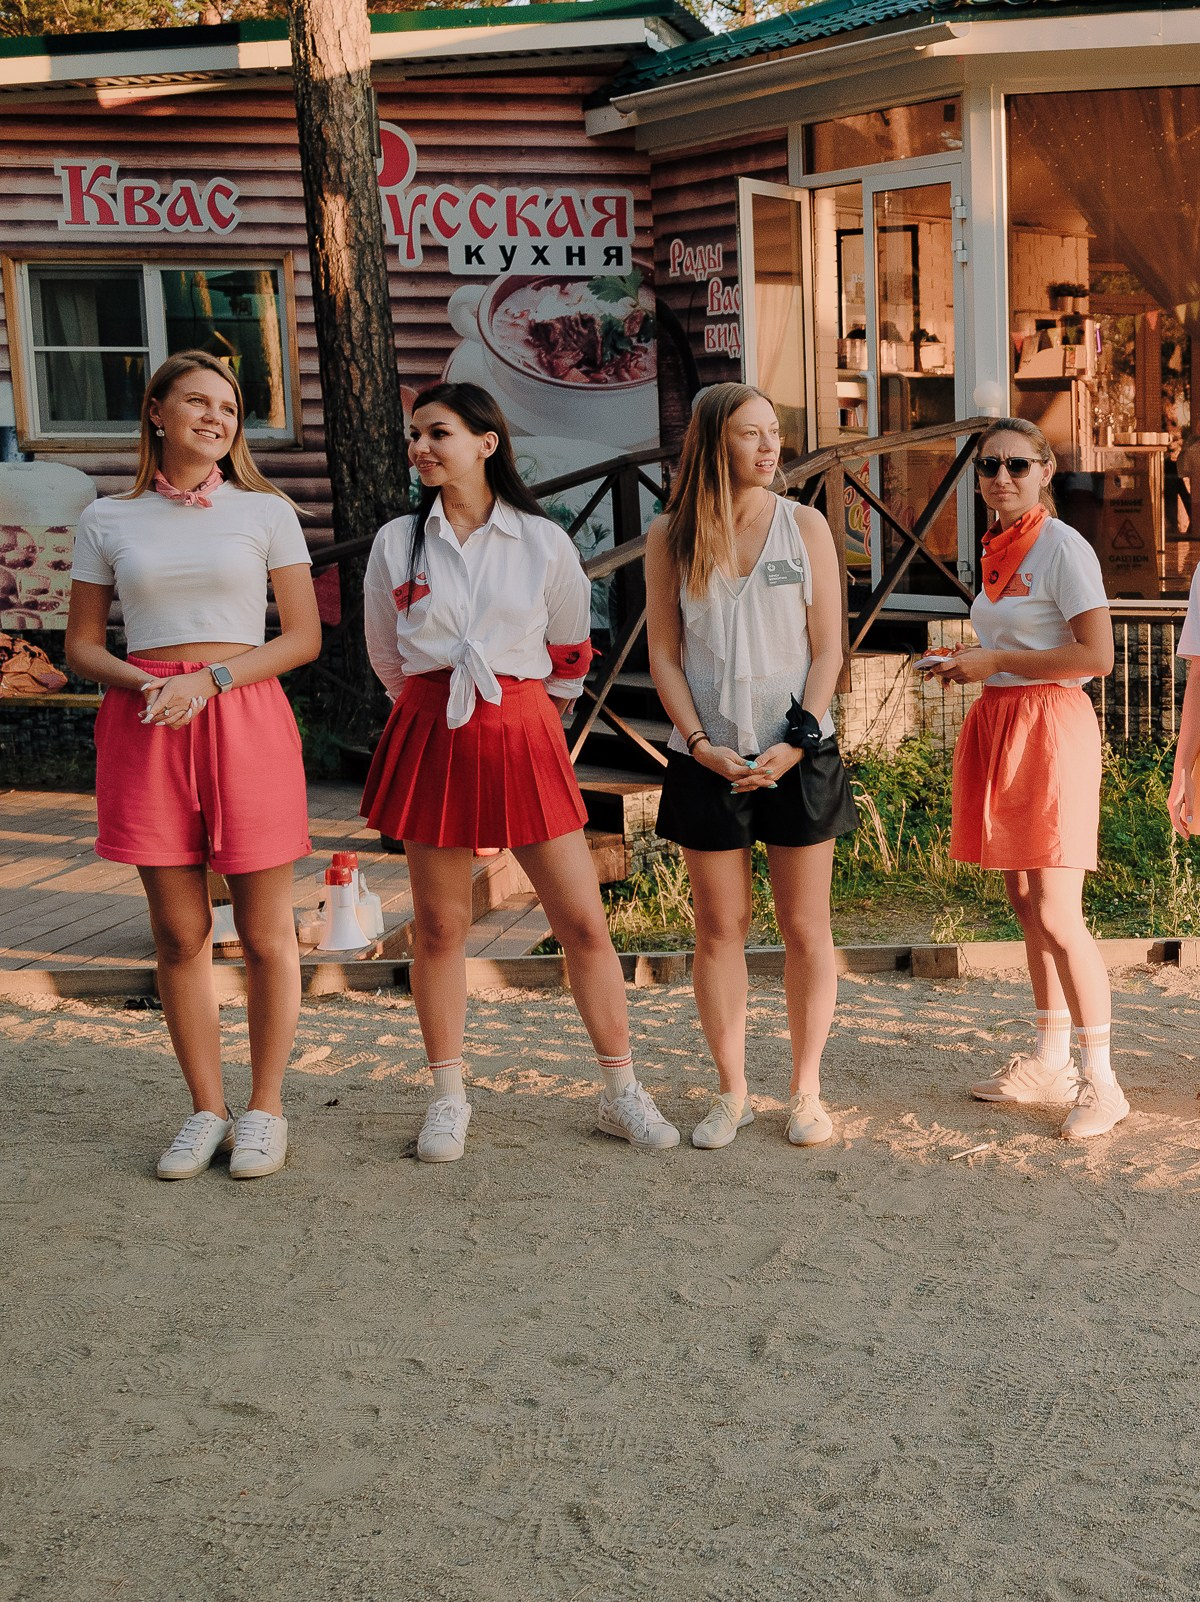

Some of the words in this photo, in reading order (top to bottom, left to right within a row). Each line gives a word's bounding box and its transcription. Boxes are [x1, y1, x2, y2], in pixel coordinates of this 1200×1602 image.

[59, 163, 237, 231] Квас
[464, 244, 624, 271] кухня
[670, 240, 722, 280] Рады
